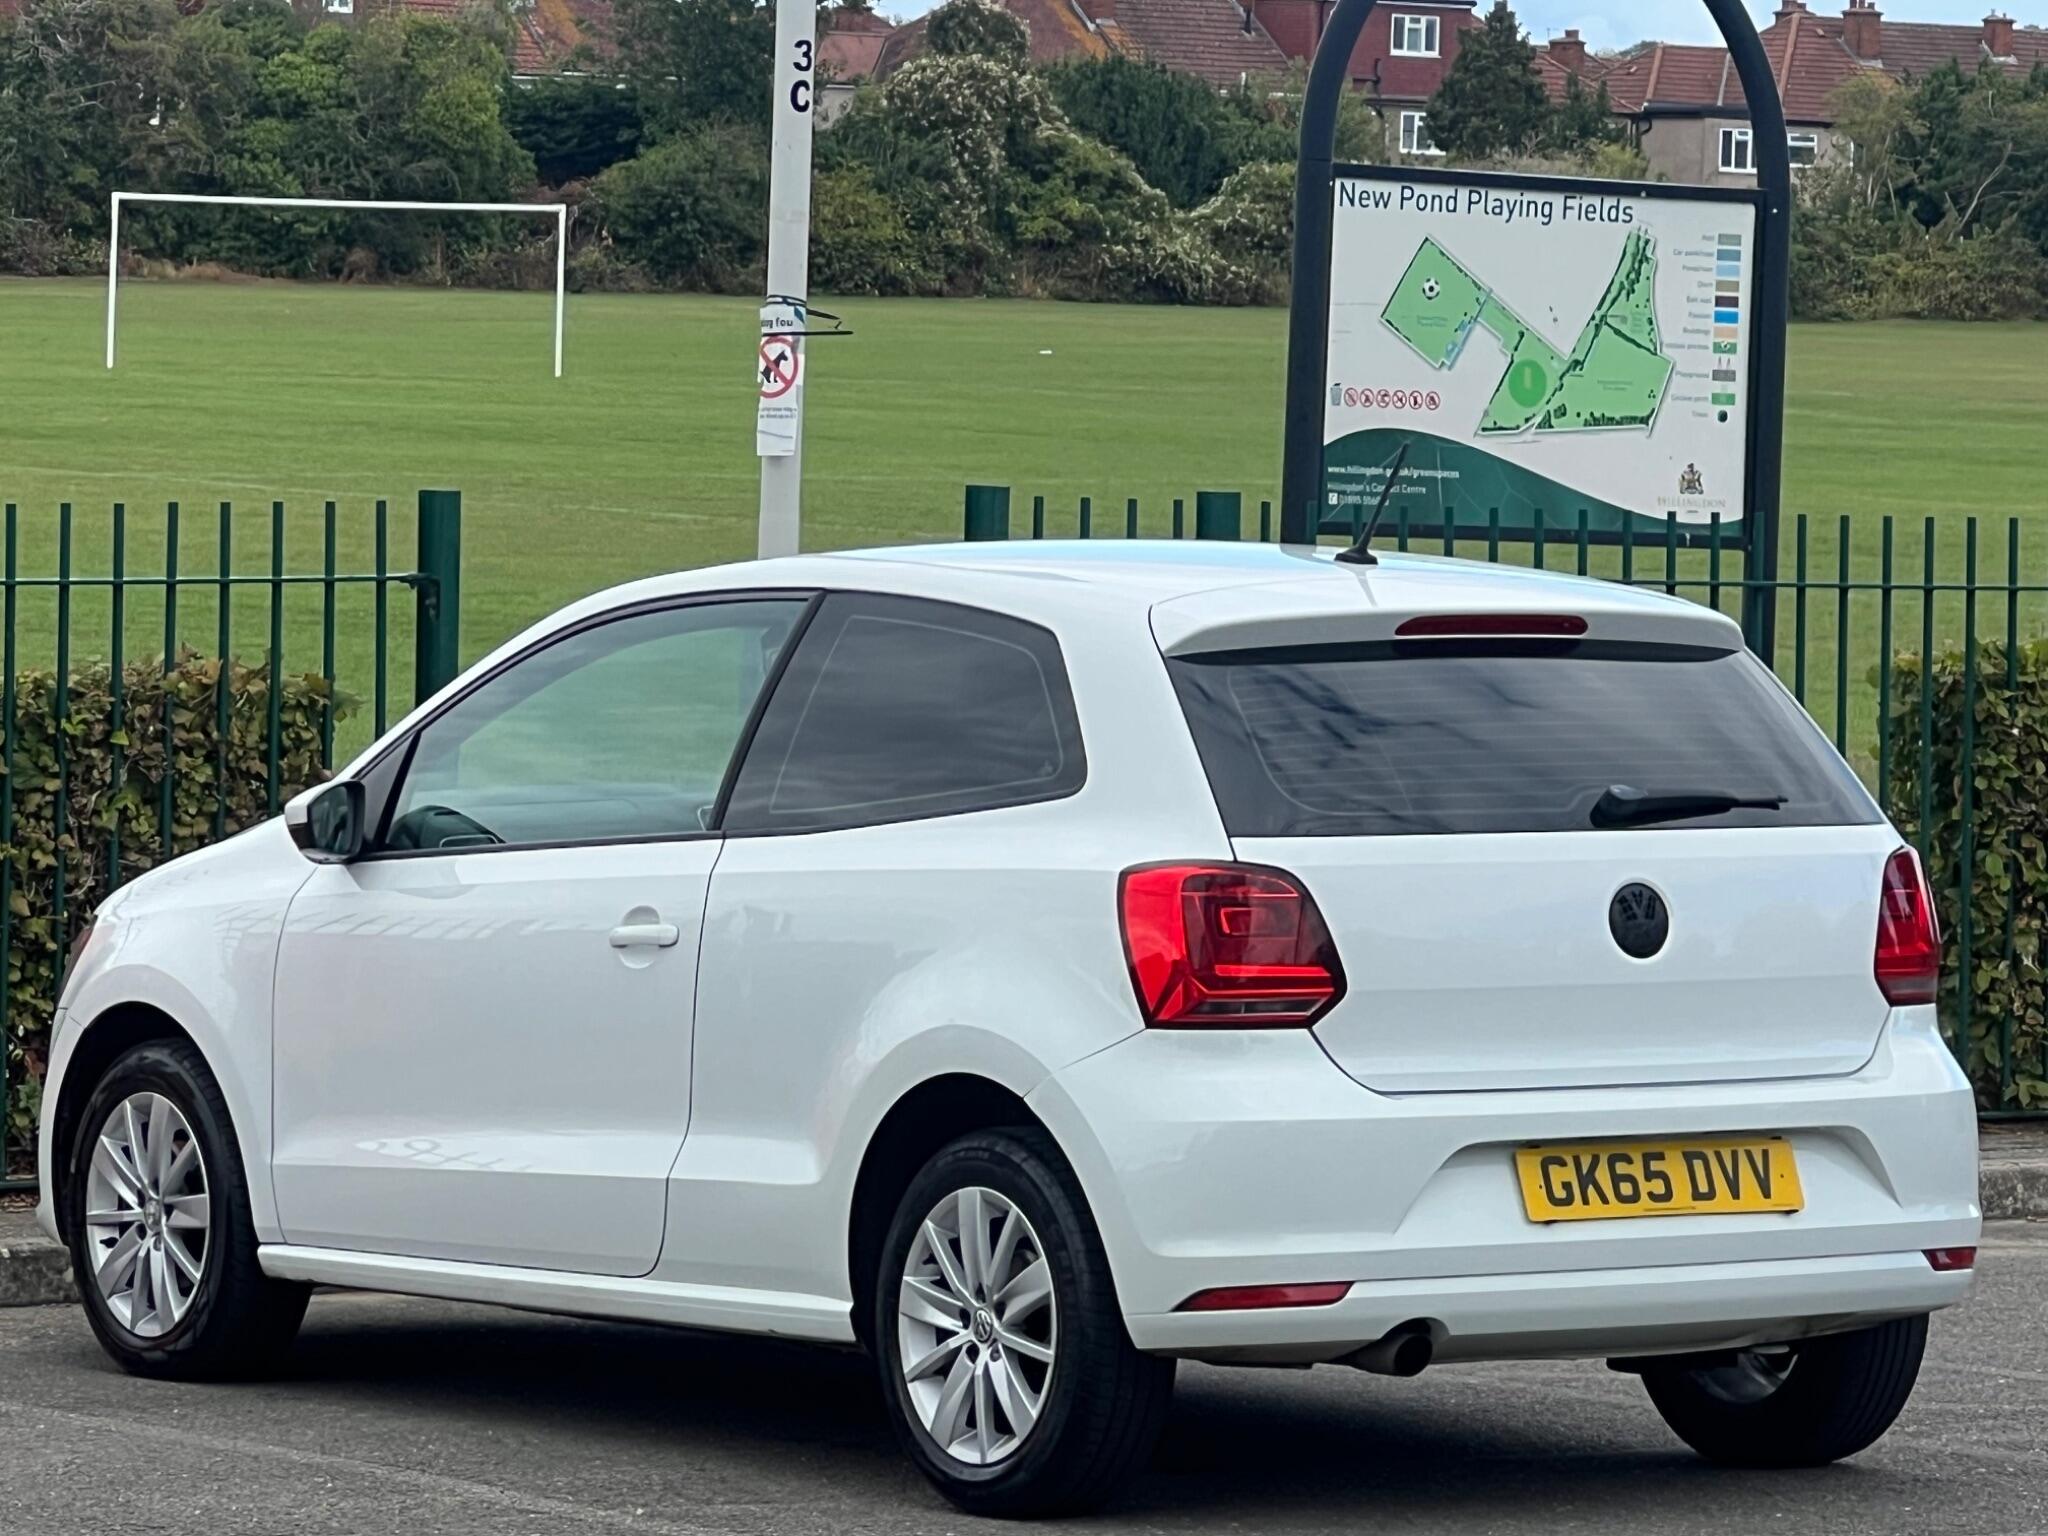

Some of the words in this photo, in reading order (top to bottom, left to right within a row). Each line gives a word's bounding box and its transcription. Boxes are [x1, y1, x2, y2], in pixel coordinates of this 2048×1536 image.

[1339, 181, 1391, 210] New
[1400, 185, 1458, 213] Pond
[1467, 189, 1553, 226] Playing
[1562, 194, 1633, 224] Fields
[1540, 1151, 1674, 1207] GK65
[1681, 1148, 1772, 1202] DVV
